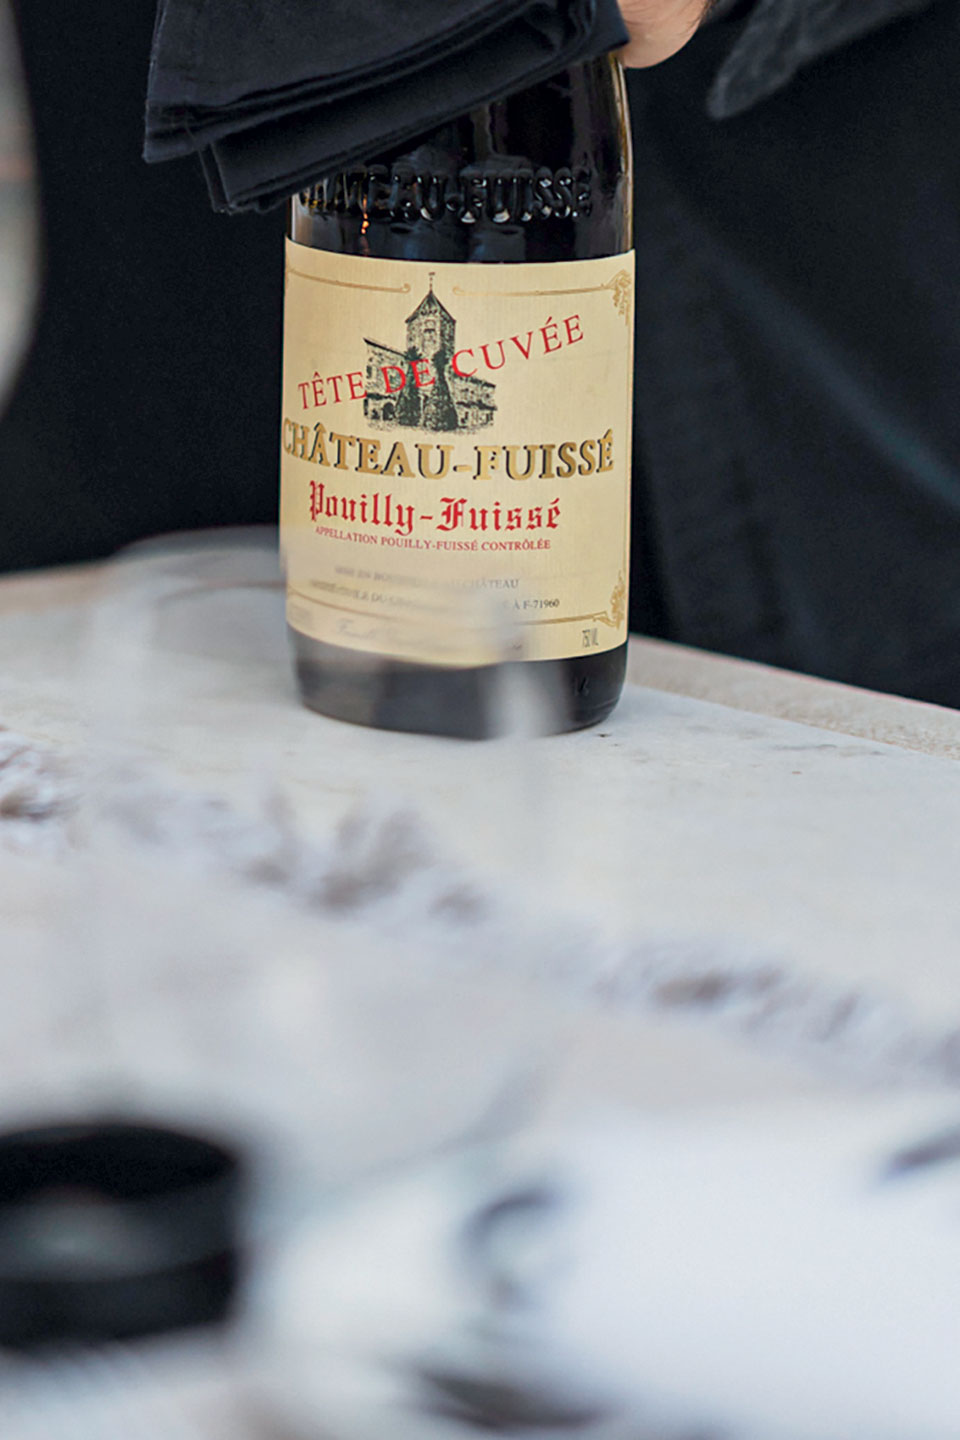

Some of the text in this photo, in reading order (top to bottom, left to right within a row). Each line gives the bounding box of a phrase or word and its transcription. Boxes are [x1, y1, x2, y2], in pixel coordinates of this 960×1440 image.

[297, 314, 585, 410] TÊTE DE CUVÉE
[283, 417, 615, 480] CHÂTEAU-FUISSÉ
[309, 479, 561, 537] Pouilly-Fuissé
[315, 525, 552, 552] APPELLATION POUILLY-FUISSÉ CONTRÔLÉE
